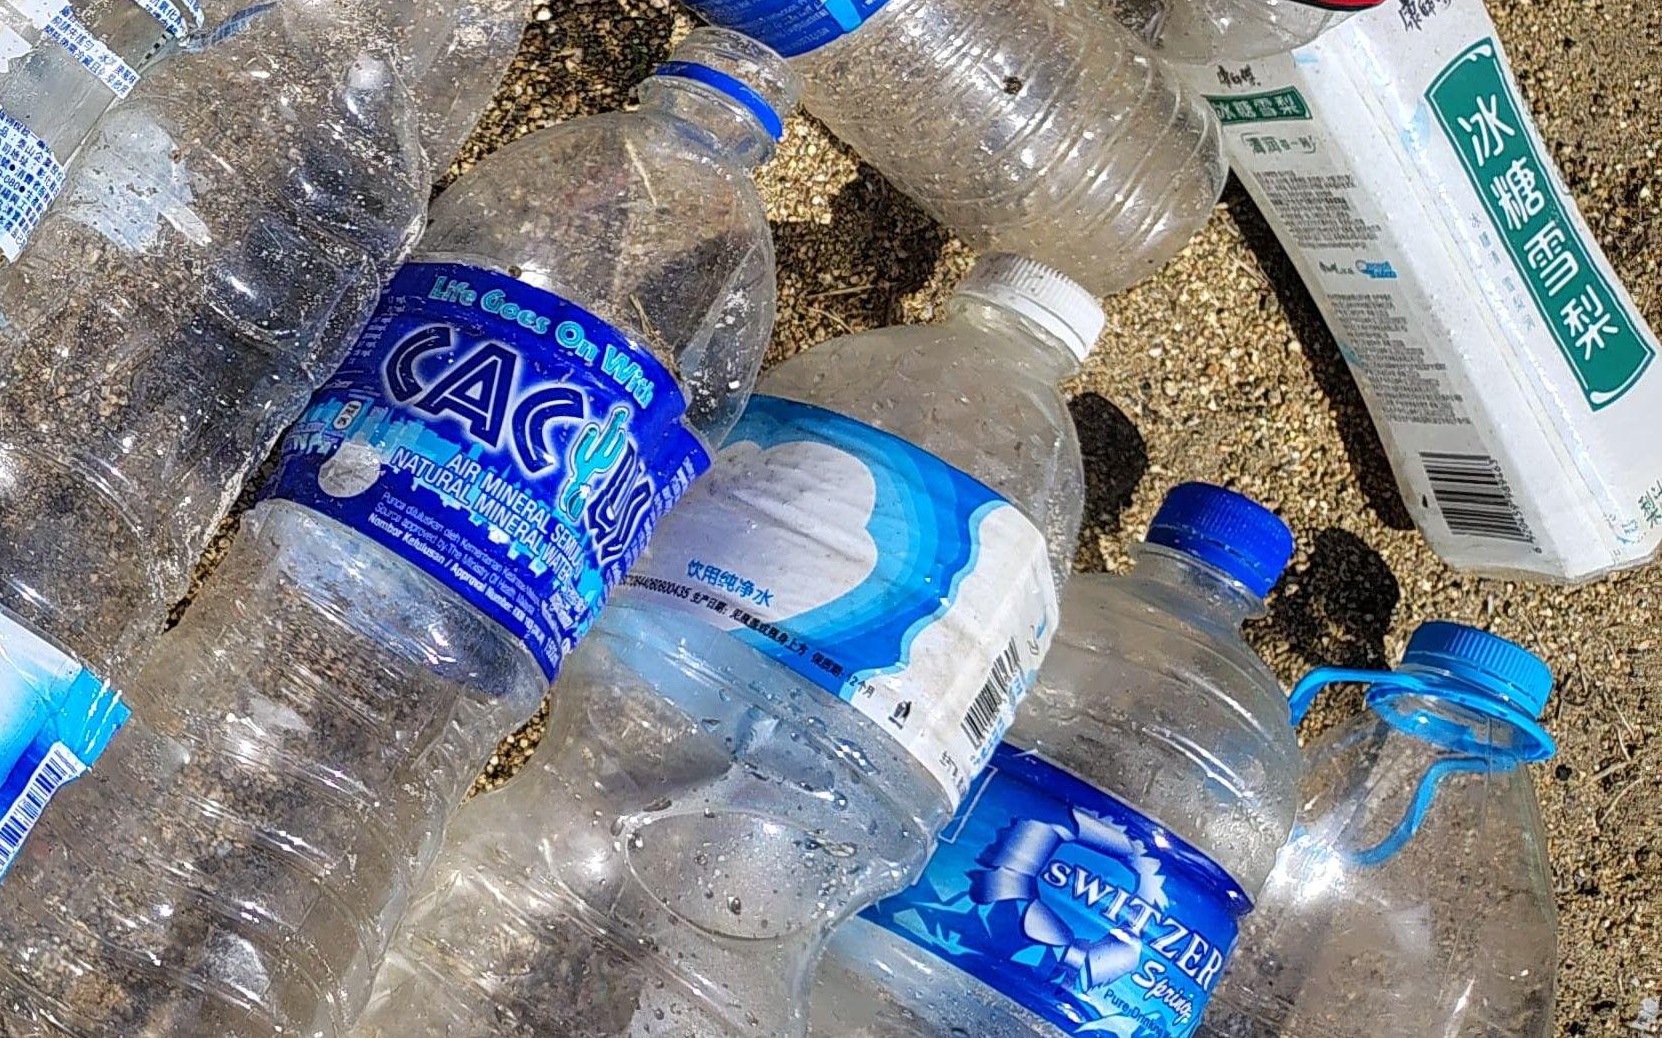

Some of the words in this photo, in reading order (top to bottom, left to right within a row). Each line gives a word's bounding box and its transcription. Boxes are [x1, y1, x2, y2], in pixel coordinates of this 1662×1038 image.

[1458, 93, 1619, 361] 冰糖雪梨
[429, 275, 476, 308] Life
[480, 288, 551, 337] Goes
[555, 320, 600, 363] On
[601, 344, 655, 410] With
[381, 492, 405, 511] Punca
[392, 447, 470, 506] NATURAL
[474, 493, 545, 557] MINERAL
[540, 541, 575, 584] WATER
[401, 516, 438, 548] approved
[446, 453, 481, 483] AIR
[480, 473, 552, 534] MINERAL
[368, 513, 404, 538] Nombor
[402, 531, 446, 564] Kelulusan
[450, 562, 487, 593] Approval
[687, 559, 775, 608] 饮用纯净水
[1043, 859, 1224, 991] SWITZER
[1104, 988, 1130, 1013] Pure
[1131, 960, 1193, 1027] Spring
